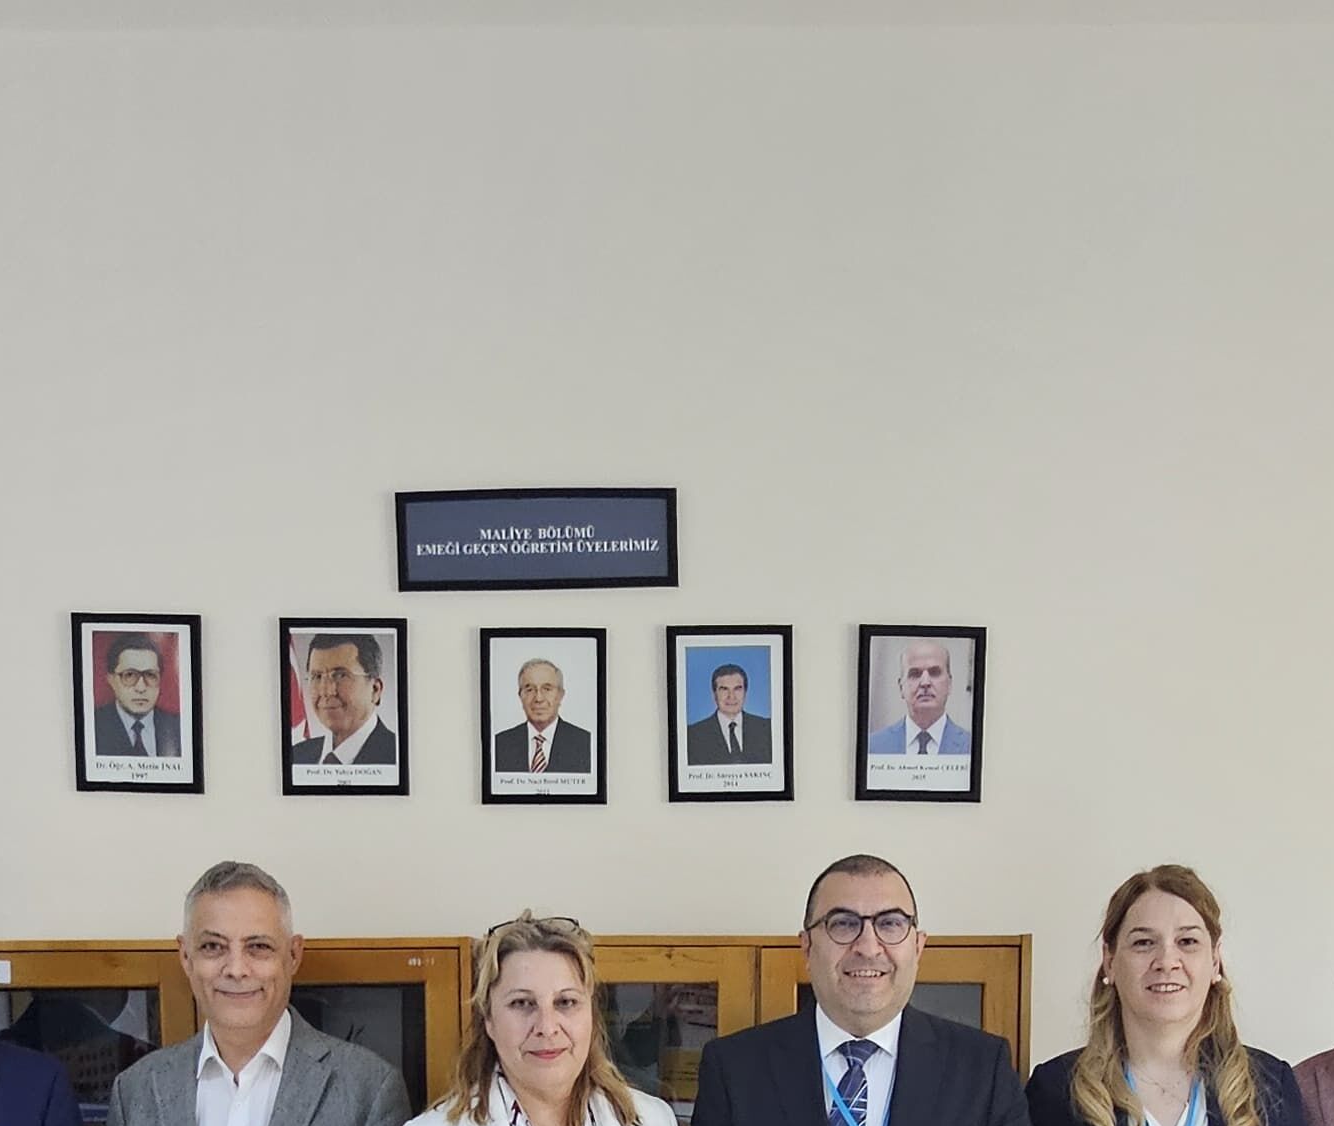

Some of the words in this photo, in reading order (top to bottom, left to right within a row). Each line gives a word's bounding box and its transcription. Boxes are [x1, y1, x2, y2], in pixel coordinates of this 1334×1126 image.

[479, 526, 532, 540] MALİYE
[538, 525, 595, 539] BÖLÜMÜ
[416, 541, 460, 556] EMEĞİ
[463, 543, 508, 556] GEÇEN
[511, 539, 574, 554] ÖĞRETİM
[577, 537, 660, 553] ÜYELERİMİZ
